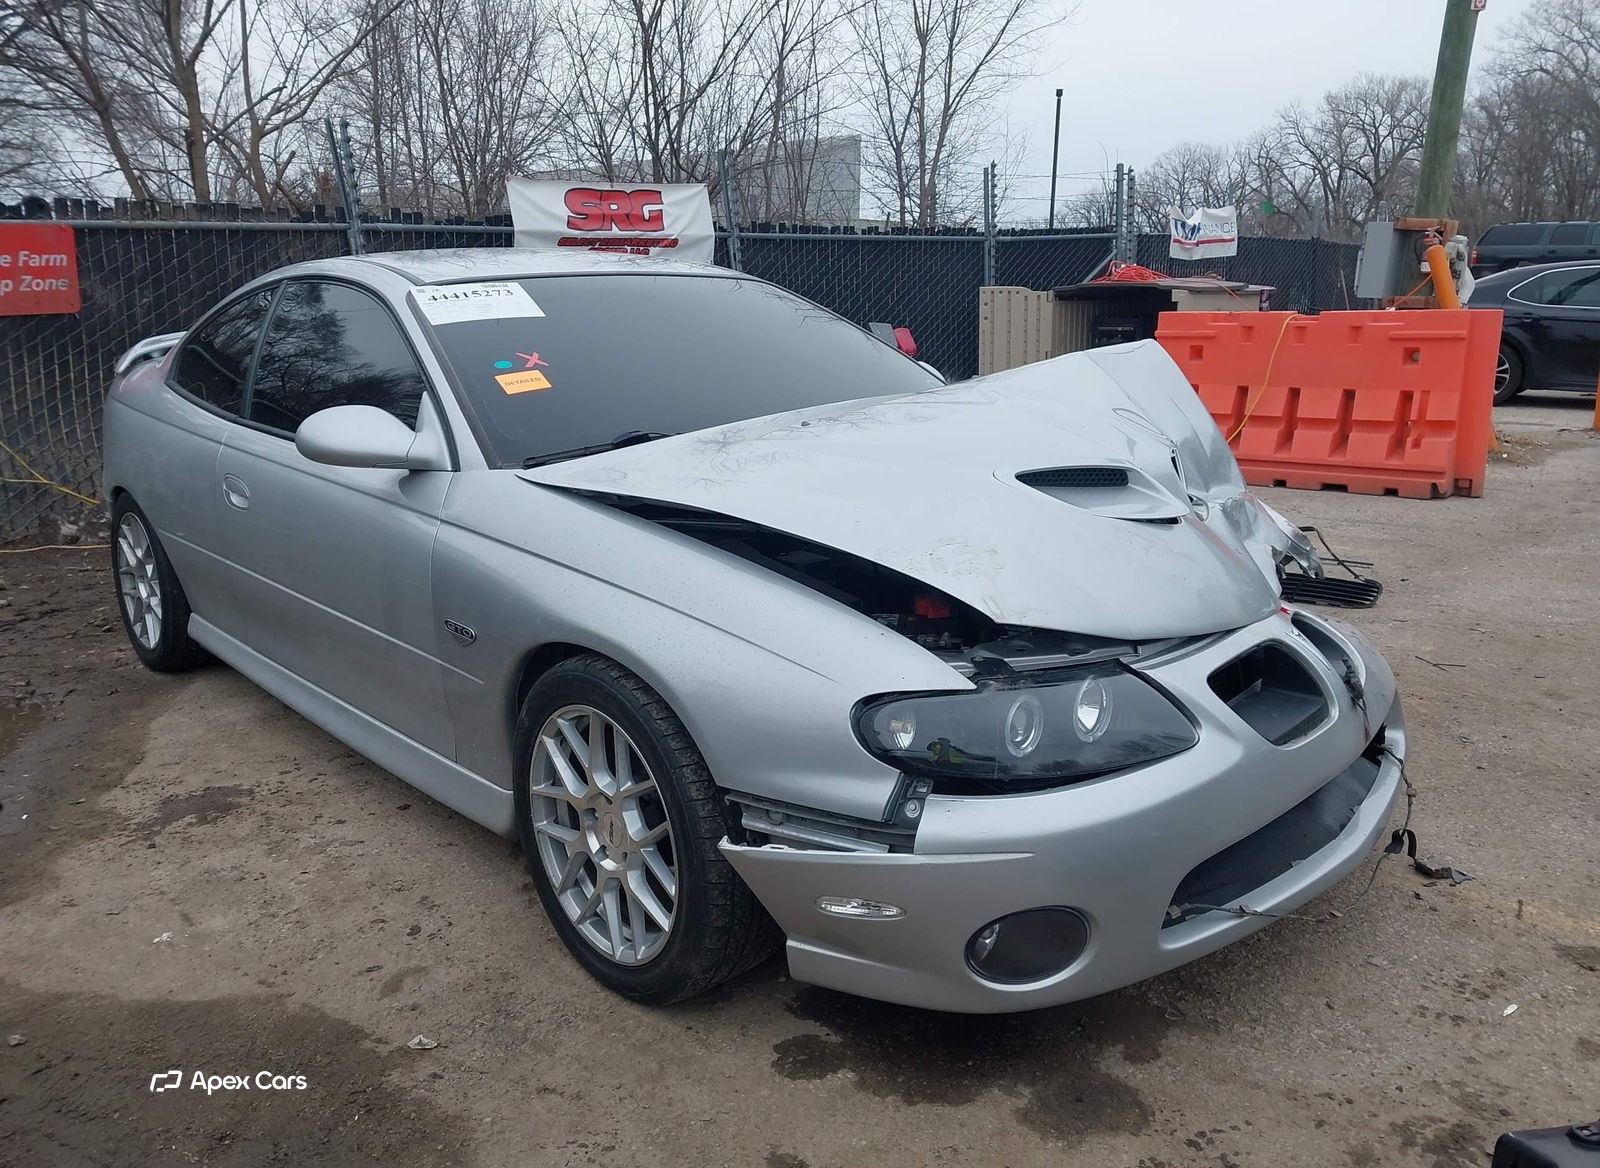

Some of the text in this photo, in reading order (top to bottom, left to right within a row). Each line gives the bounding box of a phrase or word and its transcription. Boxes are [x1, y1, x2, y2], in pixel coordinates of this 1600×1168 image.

[564, 187, 665, 232] SRG
[557, 237, 600, 247] SELECT
[18, 250, 68, 267] Farm
[19, 275, 69, 292] Zone
[427, 289, 514, 302] 44415273
[504, 377, 541, 387] DETAILED
[447, 622, 472, 637] GTO
